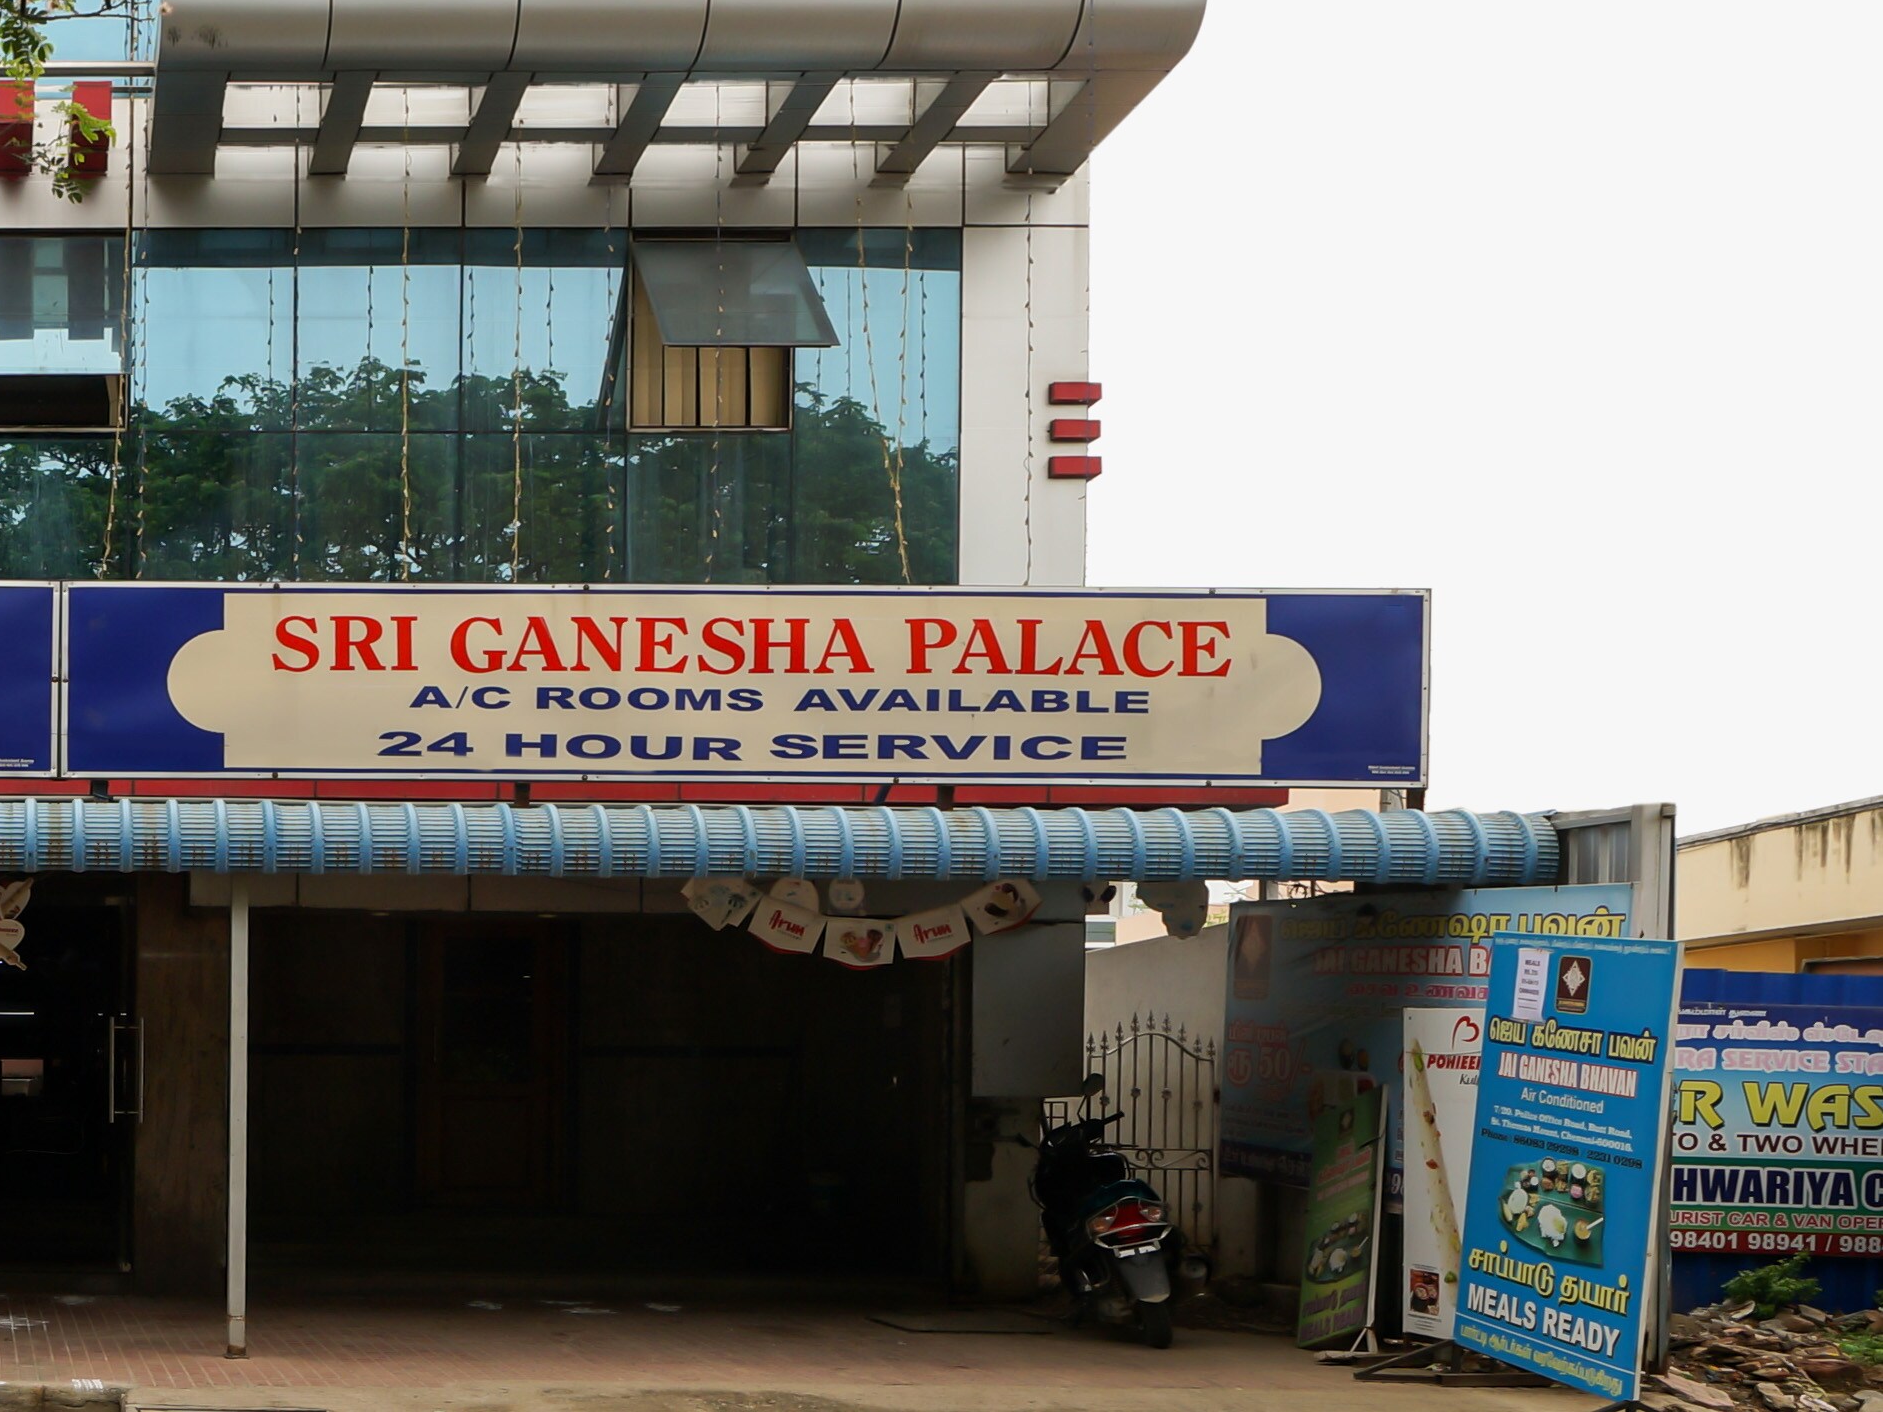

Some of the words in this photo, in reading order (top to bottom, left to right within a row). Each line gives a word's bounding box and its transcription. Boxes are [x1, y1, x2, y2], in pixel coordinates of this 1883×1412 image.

[271, 615, 419, 673] SRI
[449, 615, 875, 676] GANESHA
[904, 617, 1232, 679] PALACE
[410, 685, 511, 710] A/C
[536, 686, 764, 712] ROOMS
[794, 688, 1149, 714] AVAILABLE
[377, 731, 474, 757] 24
[505, 733, 743, 761] HOUR
[770, 733, 1128, 762] SERVICE
[768, 910, 806, 936] Arun
[913, 923, 952, 944] Arun
[1352, 945, 1465, 976] GANESHA
[1469, 945, 1492, 977] B
[1608, 1030, 1657, 1062] பவன்
[1723, 1048, 1830, 1073] SERVICE
[1498, 1051, 1518, 1078] JAI
[1519, 1055, 1578, 1088] GANESHA
[1580, 1063, 1638, 1098] BHAVAN
[1520, 1087, 1536, 1102] Air
[1538, 1090, 1604, 1114] Conditioned
[1677, 1080, 1724, 1130] R
[1708, 1133, 1727, 1152] &
[1737, 1134, 1804, 1154] TWO
[1812, 1136, 1883, 1156] WHE
[1673, 1167, 1855, 1207] HWARIYA
[1729, 1213, 1768, 1227] CAR
[1775, 1214, 1788, 1227] &
[1794, 1215, 1832, 1229] VAN
[1670, 1230, 1738, 1249] 98401
[1748, 1233, 1816, 1252] 98941
[1469, 1240, 1556, 1297] சாப்பாடு
[1558, 1274, 1631, 1316] தயார்
[1467, 1282, 1537, 1331] MEALS
[1542, 1306, 1621, 1358] READY
